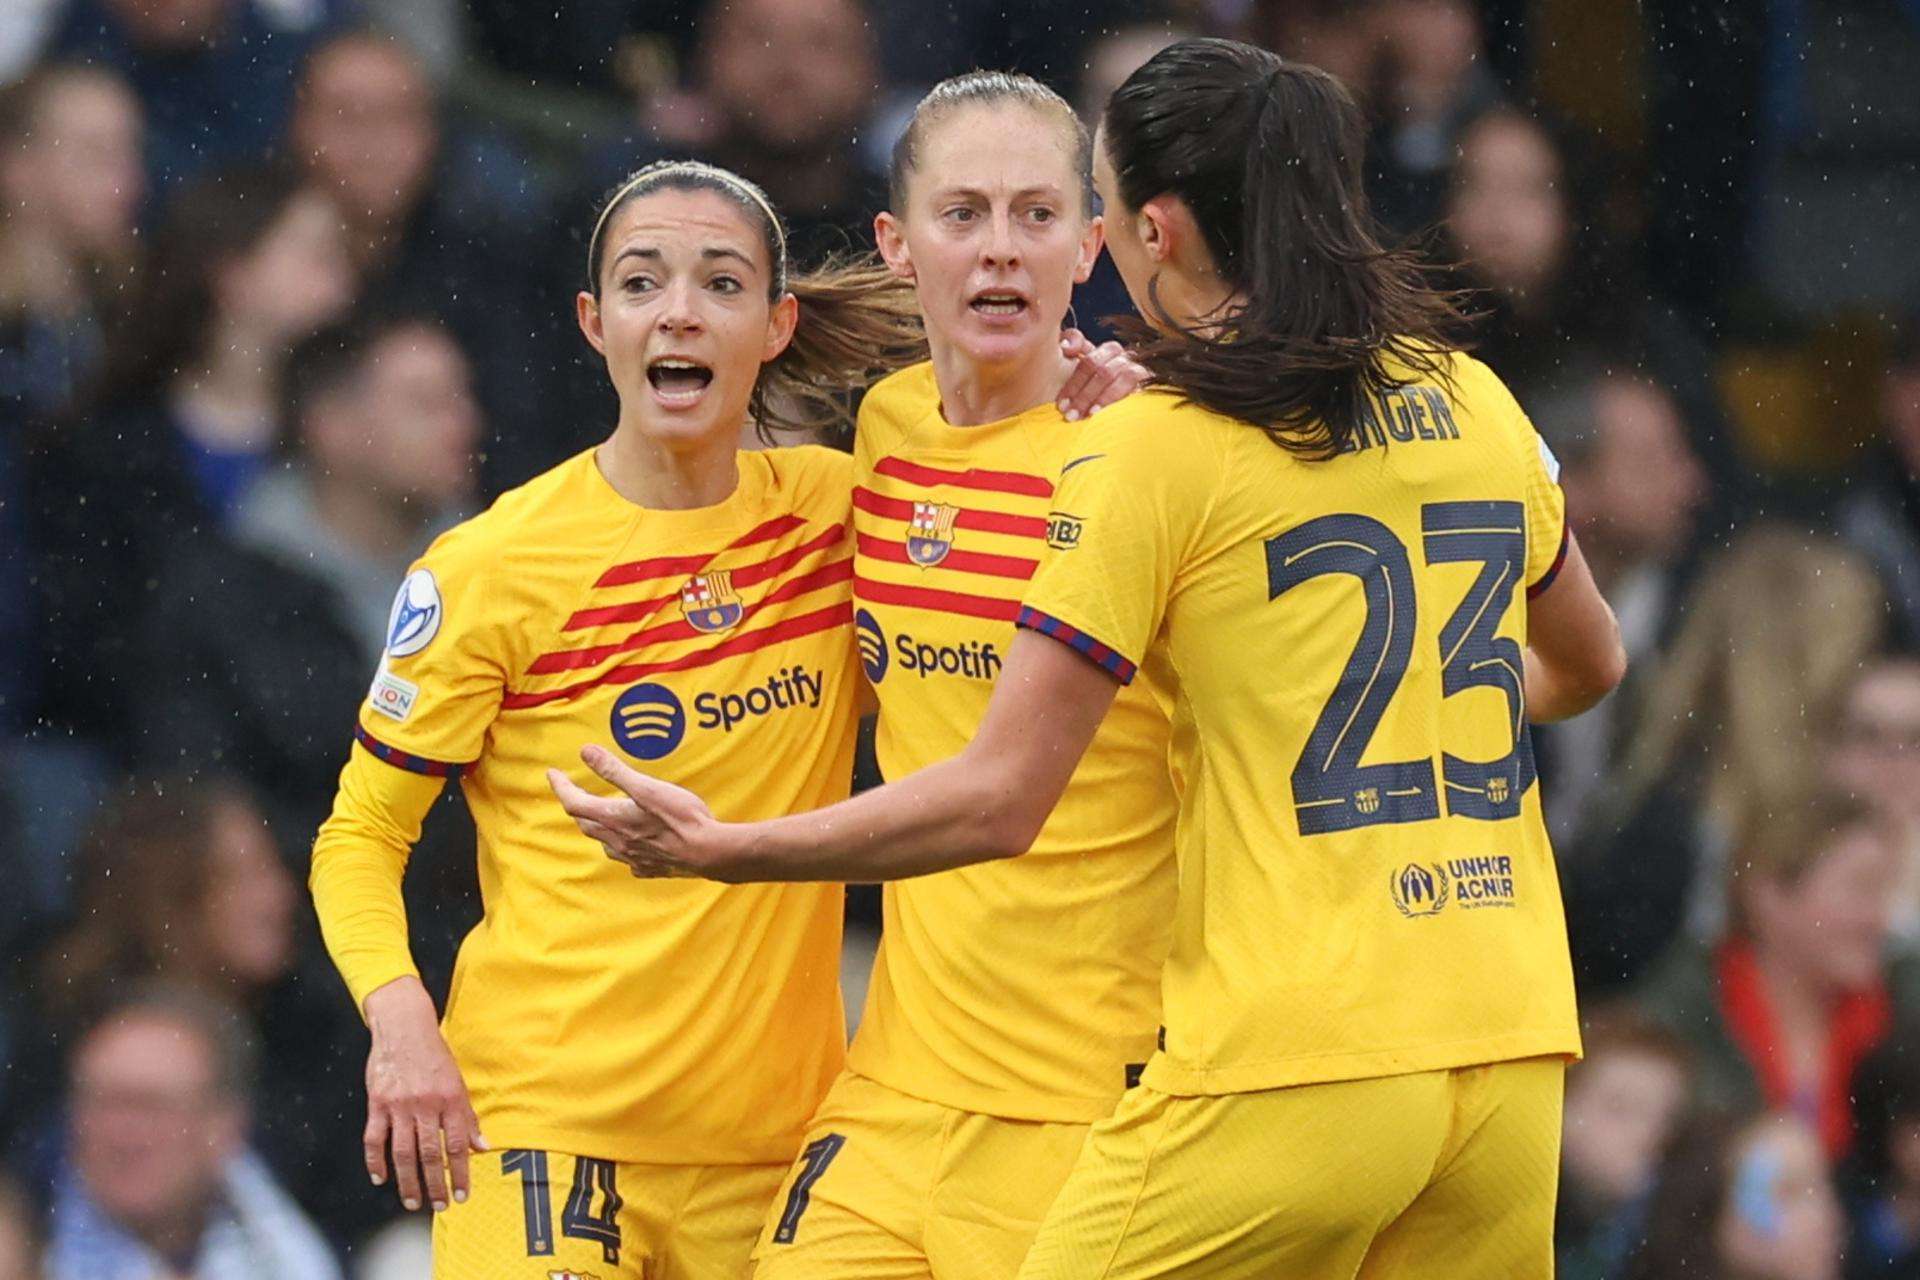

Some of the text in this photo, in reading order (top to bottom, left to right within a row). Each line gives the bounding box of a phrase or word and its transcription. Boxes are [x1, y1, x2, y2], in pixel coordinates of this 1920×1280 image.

[1338, 385, 1460, 452] NGEN
[694, 665, 823, 732] Spotify
[1264, 500, 1538, 836] 23
[500, 1149, 624, 1266] 14
